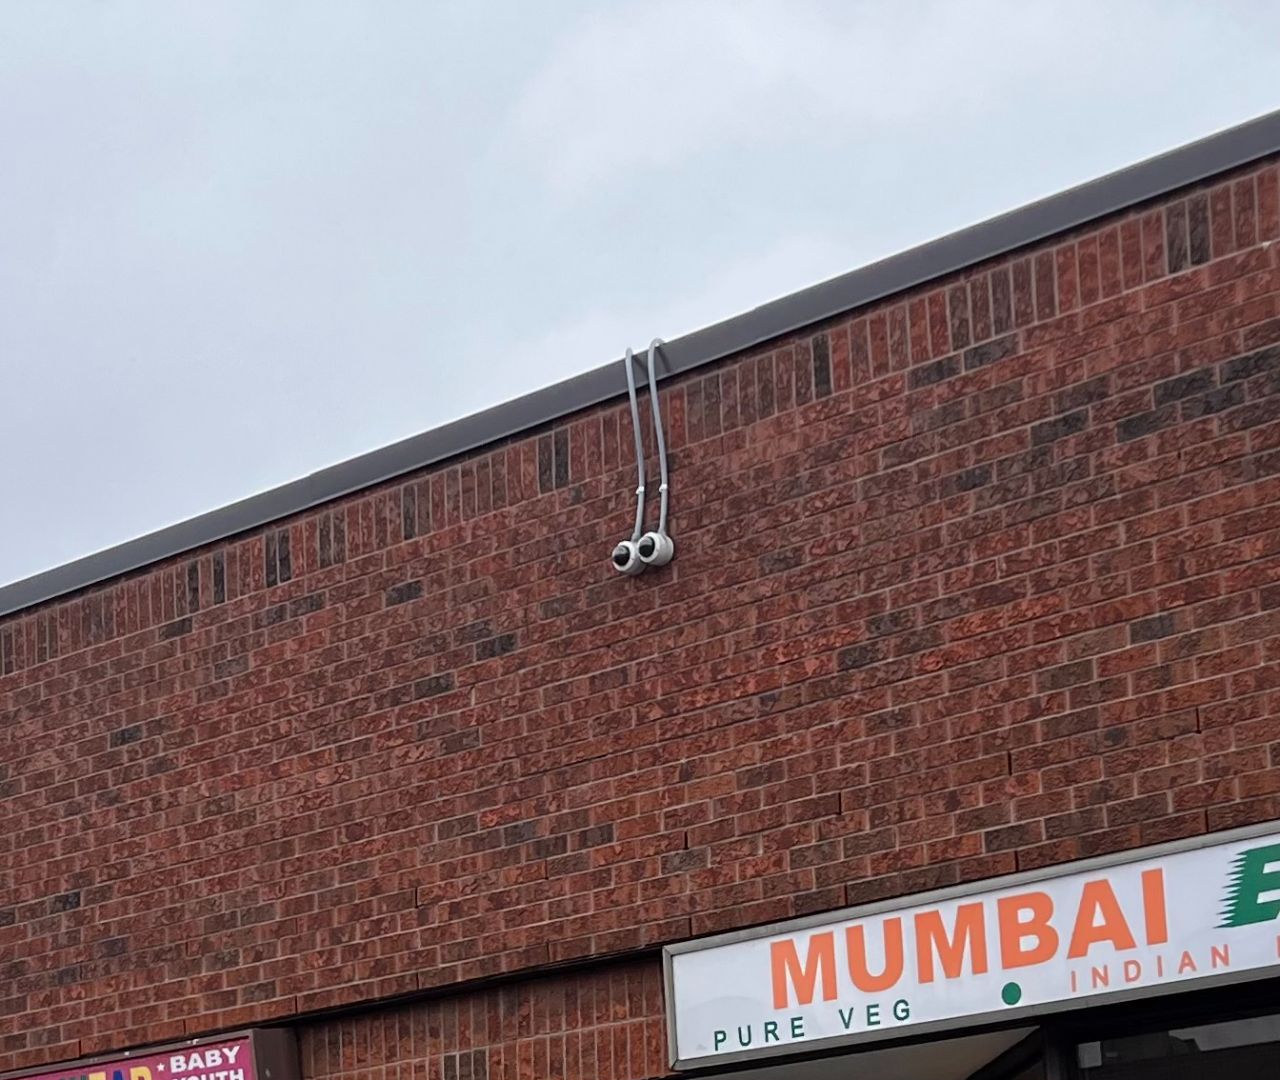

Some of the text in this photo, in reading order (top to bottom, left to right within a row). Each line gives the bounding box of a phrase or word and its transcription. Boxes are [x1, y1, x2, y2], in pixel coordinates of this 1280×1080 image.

[770, 868, 1169, 1010] MUMBAI
[1070, 943, 1231, 993] INDIAN
[713, 998, 912, 1052] PURE VEG
[170, 1045, 241, 1073] BABY
